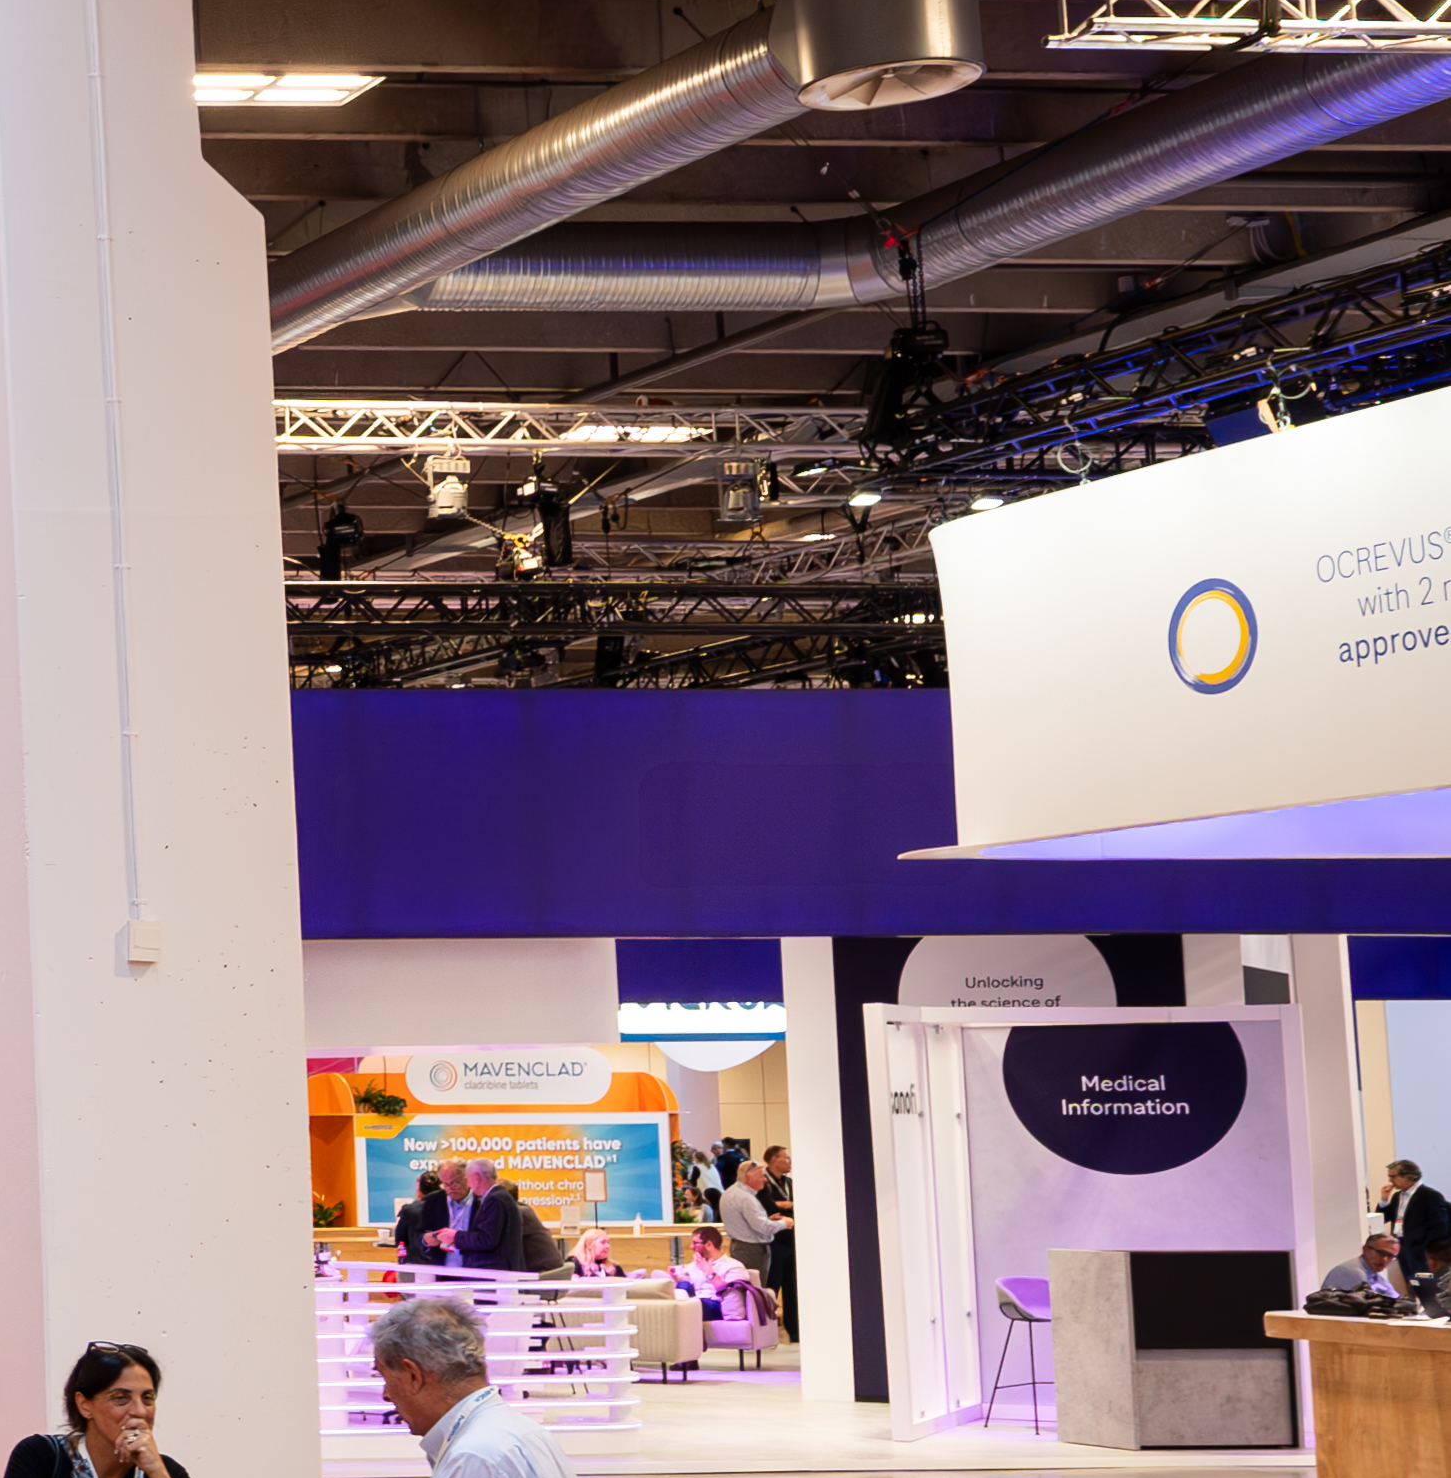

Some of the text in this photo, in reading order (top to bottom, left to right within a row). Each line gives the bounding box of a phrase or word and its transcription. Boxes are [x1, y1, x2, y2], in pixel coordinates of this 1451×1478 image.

[1357, 576, 1435, 617] with 2
[1338, 625, 1451, 667] approve
[964, 975, 1044, 990] Unlocking
[951, 995, 1062, 1008] the science of
[464, 1080, 539, 1090] cladribine tablets
[1081, 1075, 1167, 1092] Medical
[1061, 1098, 1190, 1116] Information
[403, 1137, 621, 1153] Now >100,000 patients have
[517, 1179, 584, 1191] ithout chro
